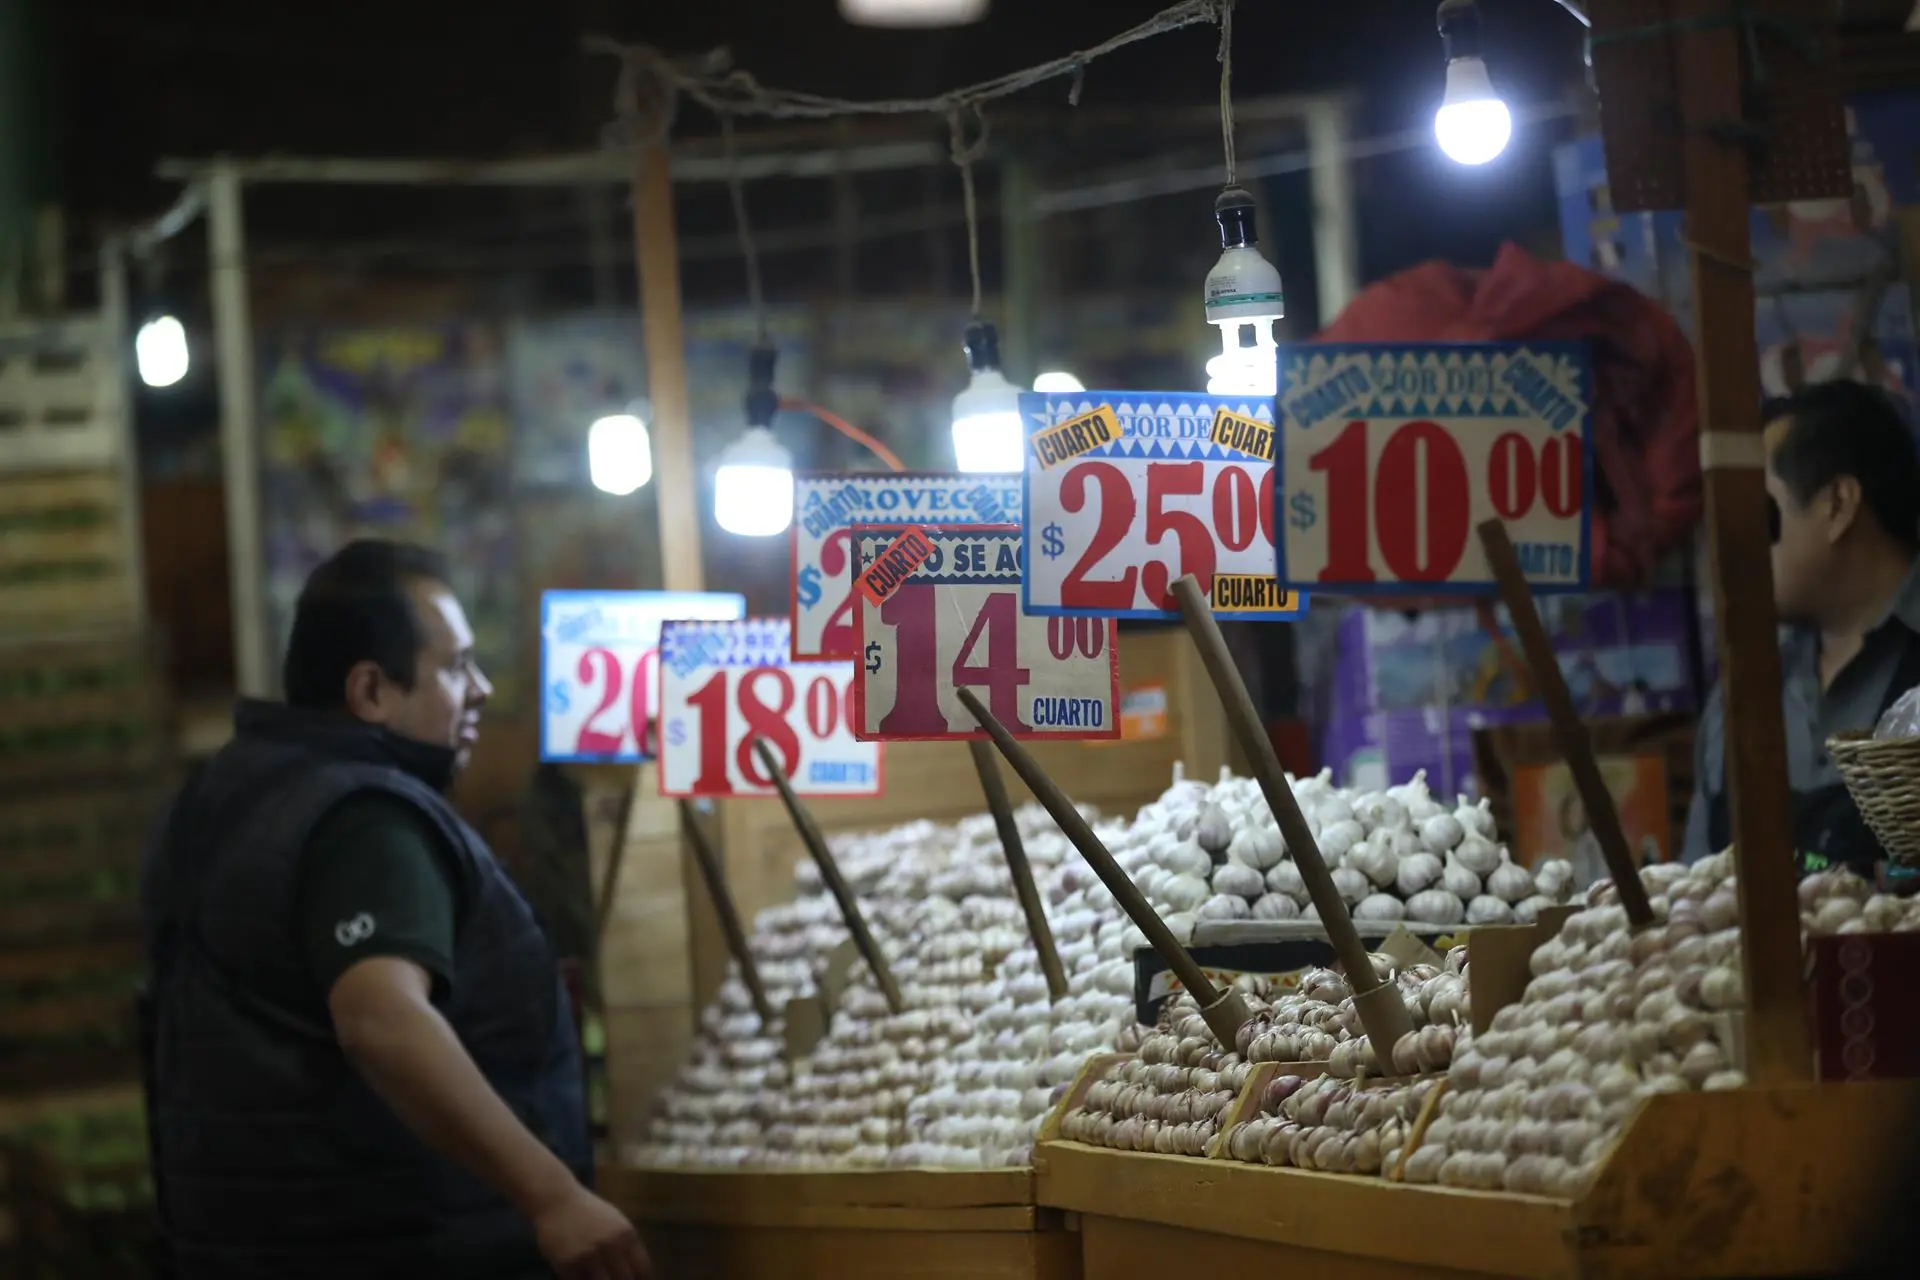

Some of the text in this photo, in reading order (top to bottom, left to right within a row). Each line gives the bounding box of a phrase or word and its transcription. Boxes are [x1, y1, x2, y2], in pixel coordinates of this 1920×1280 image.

[1038, 415, 1110, 465] CUARTO
[1309, 420, 1470, 582] 10
[1488, 431, 1581, 520] 00
[866, 534, 928, 596] CUARTO
[953, 544, 986, 572] SE
[1041, 522, 1065, 560] $
[1060, 461, 1217, 611] 25
[1218, 577, 1288, 608] CUARTO
[879, 584, 1033, 734] 14
[685, 667, 801, 795] 18
[1033, 697, 1103, 728] CUARTO
